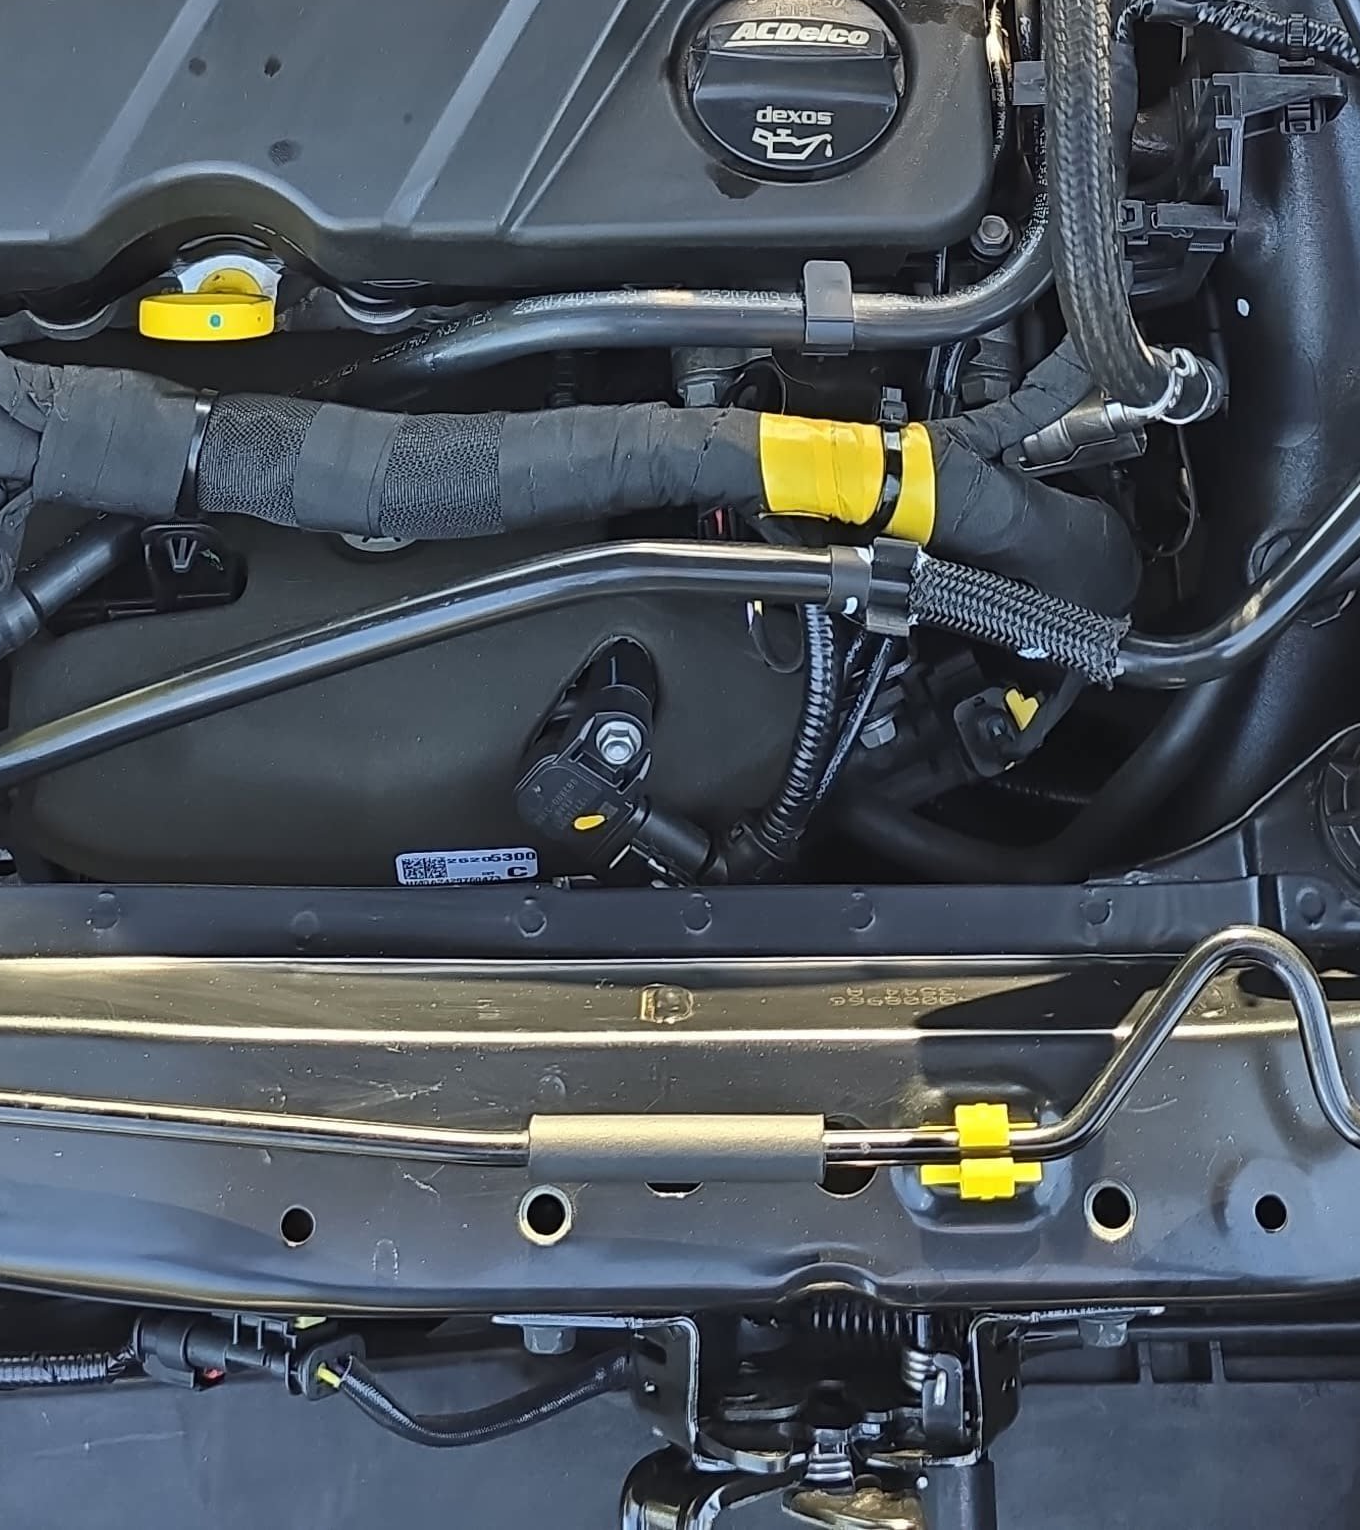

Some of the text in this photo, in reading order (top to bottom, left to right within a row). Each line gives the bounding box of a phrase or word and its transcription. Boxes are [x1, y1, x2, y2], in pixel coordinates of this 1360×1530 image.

[729, 21, 871, 46] ACDelco
[756, 106, 835, 126] dexos
[447, 851, 537, 865] 26205300
[507, 866, 529, 878] C
